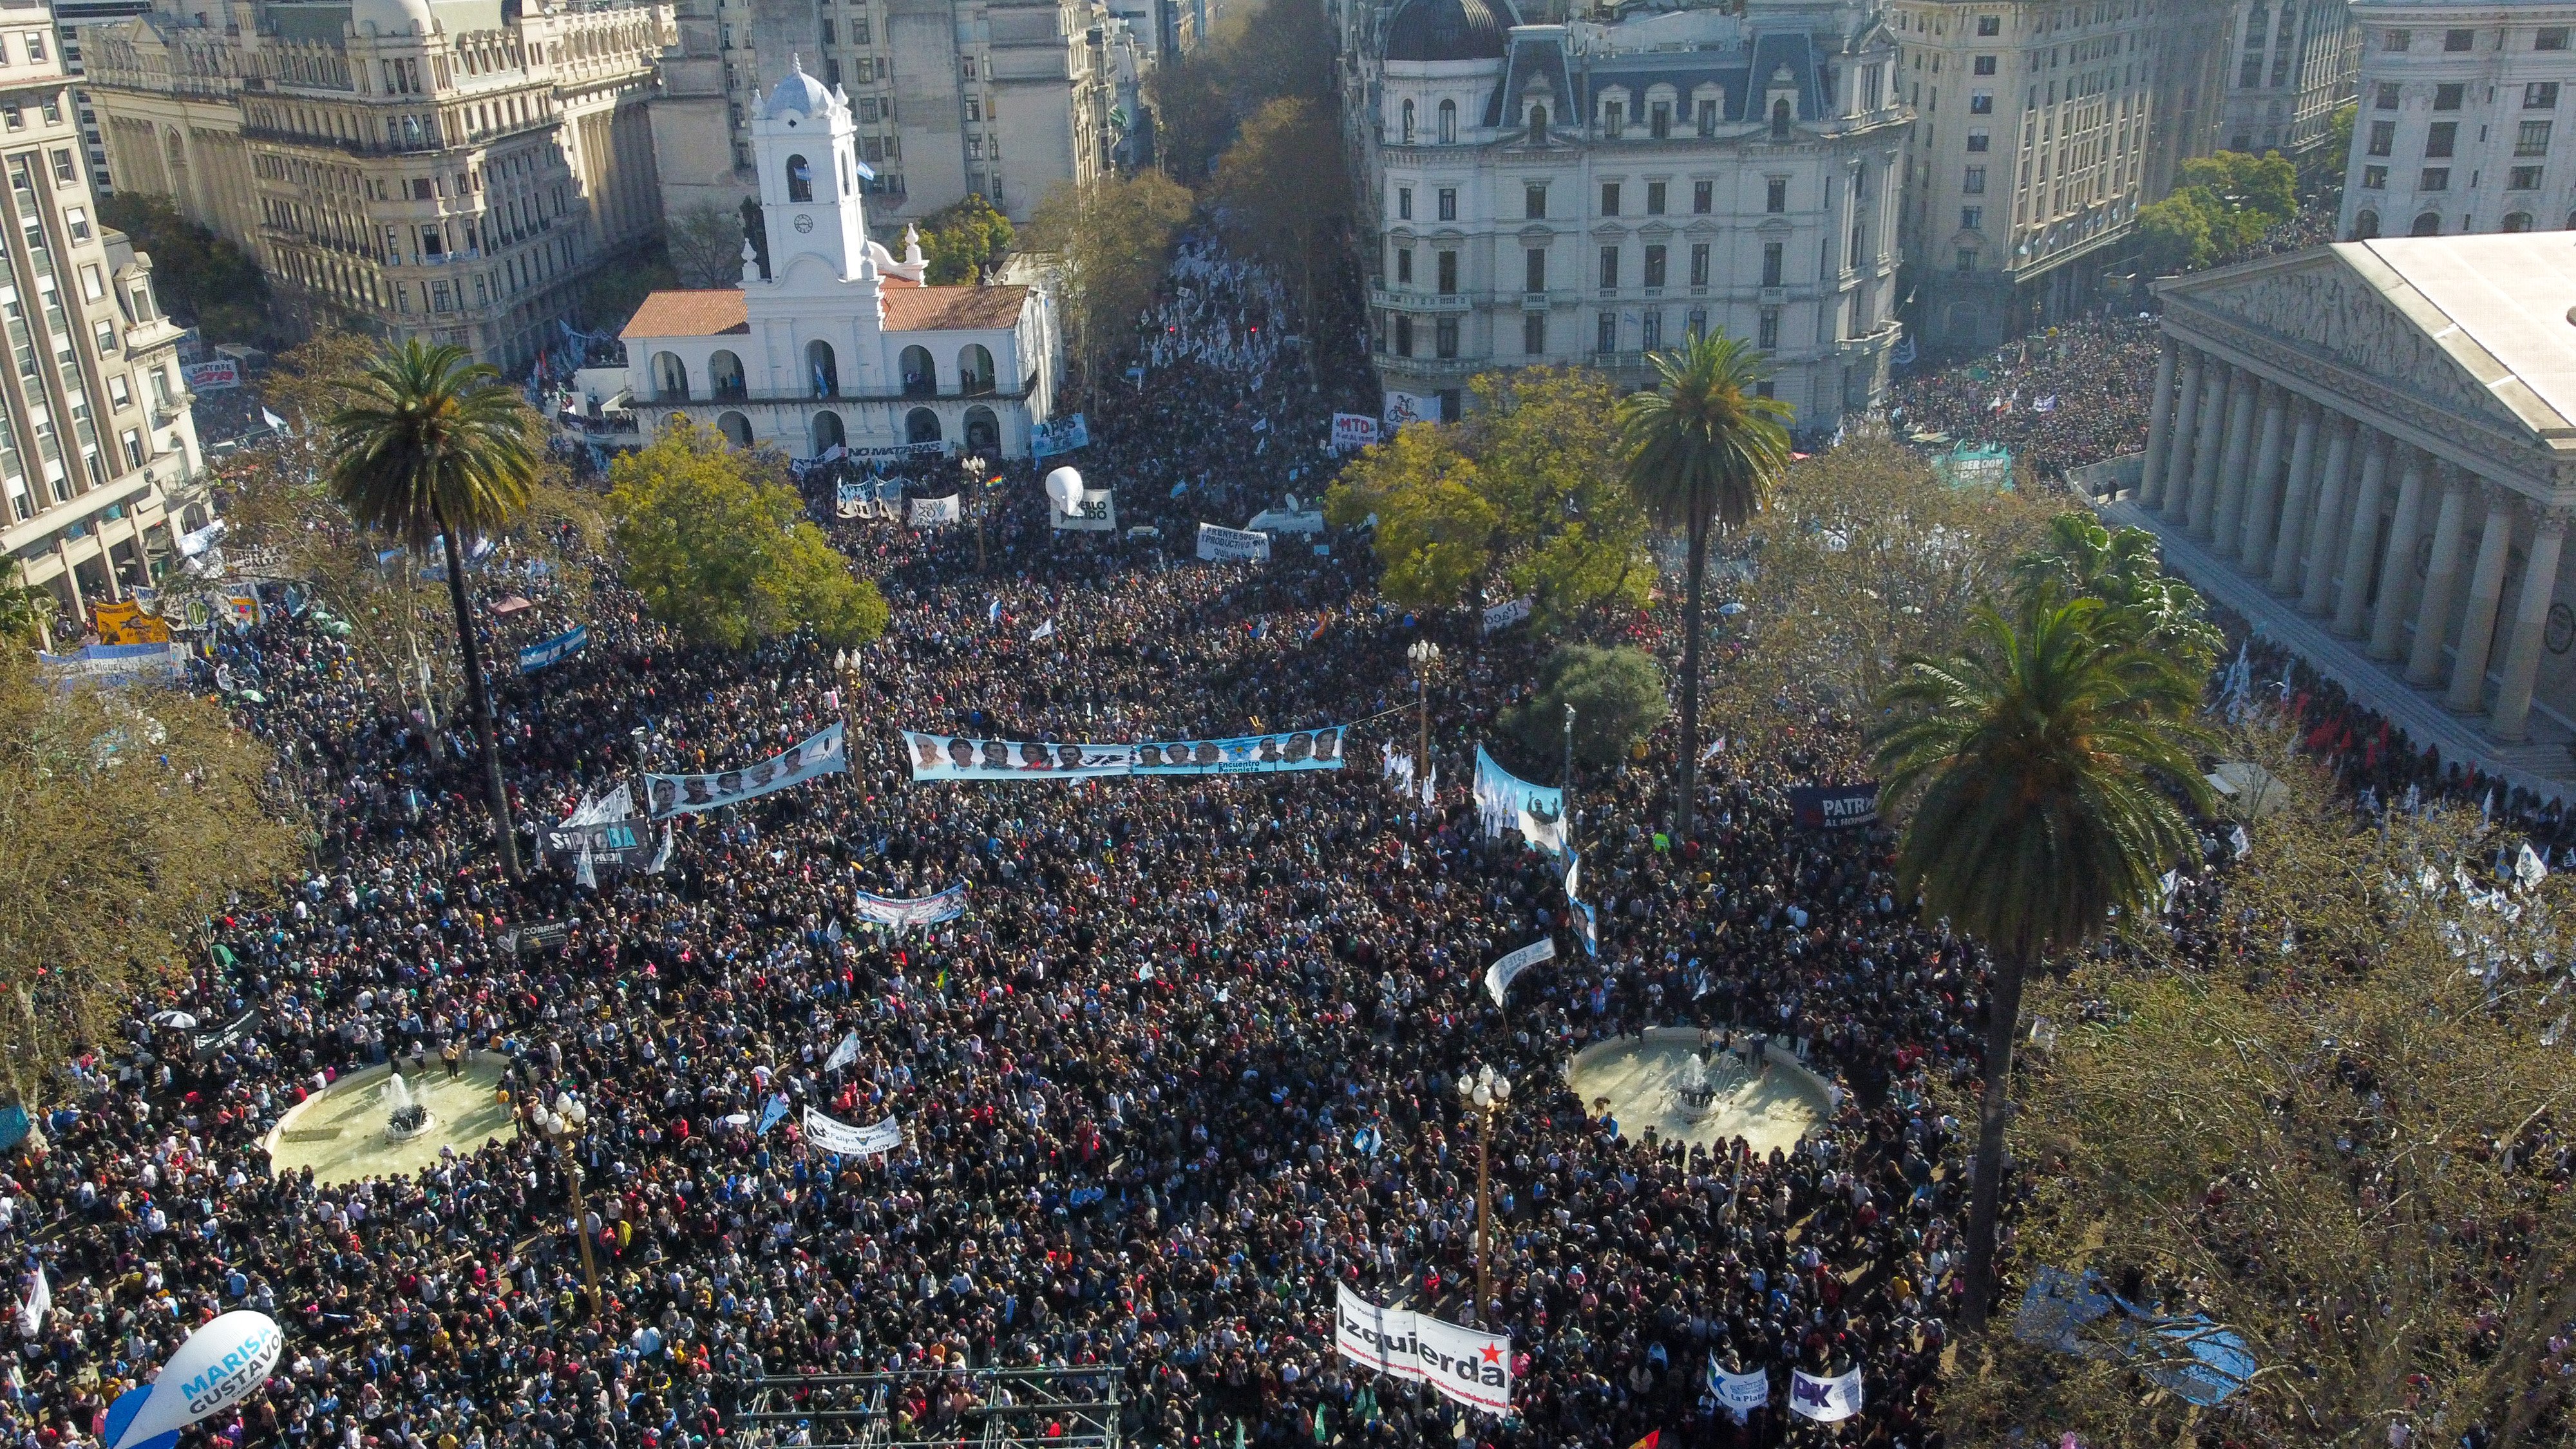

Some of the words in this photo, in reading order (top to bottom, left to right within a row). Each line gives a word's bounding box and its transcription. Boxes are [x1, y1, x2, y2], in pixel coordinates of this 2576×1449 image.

[1340, 417, 1370, 434] MTD
[848, 446, 871, 457] NO
[1207, 527, 1238, 540] FRENTE
[523, 922, 565, 935] CORREPI
[842, 1142, 891, 1153] CHIVILCOY
[1338, 1302, 1506, 1388] Izquierda
[180, 1326, 271, 1401] MARISA
[189, 1334, 280, 1414] GUSTAVO
[1730, 1393, 1741, 1402] La
[1792, 1373, 1834, 1408] PK
